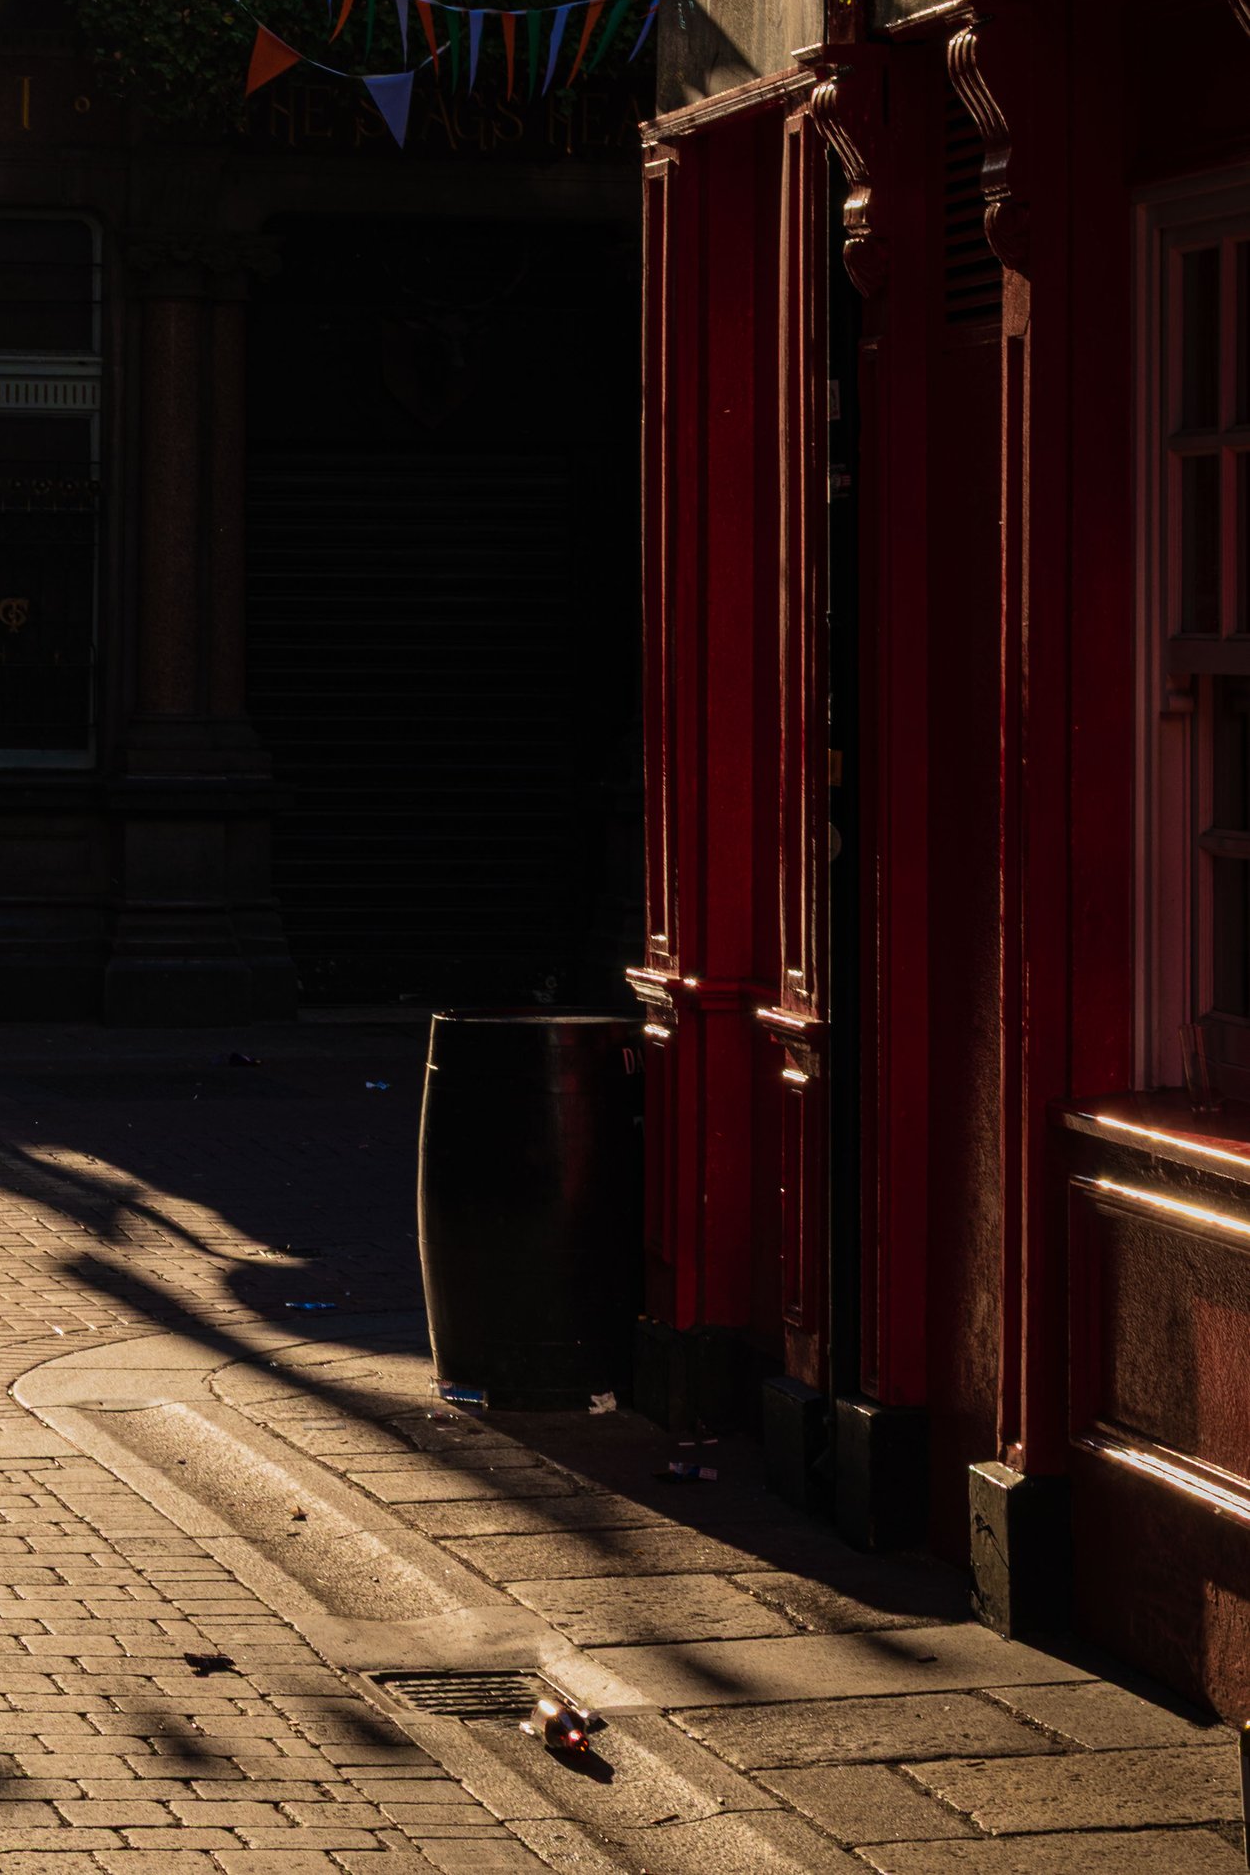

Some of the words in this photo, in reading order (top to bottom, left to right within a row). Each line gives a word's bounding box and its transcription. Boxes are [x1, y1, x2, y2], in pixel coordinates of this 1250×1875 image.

[352, 87, 525, 151] SAGS
[546, 92, 642, 155] HEA
[622, 1047, 646, 1075] DA
